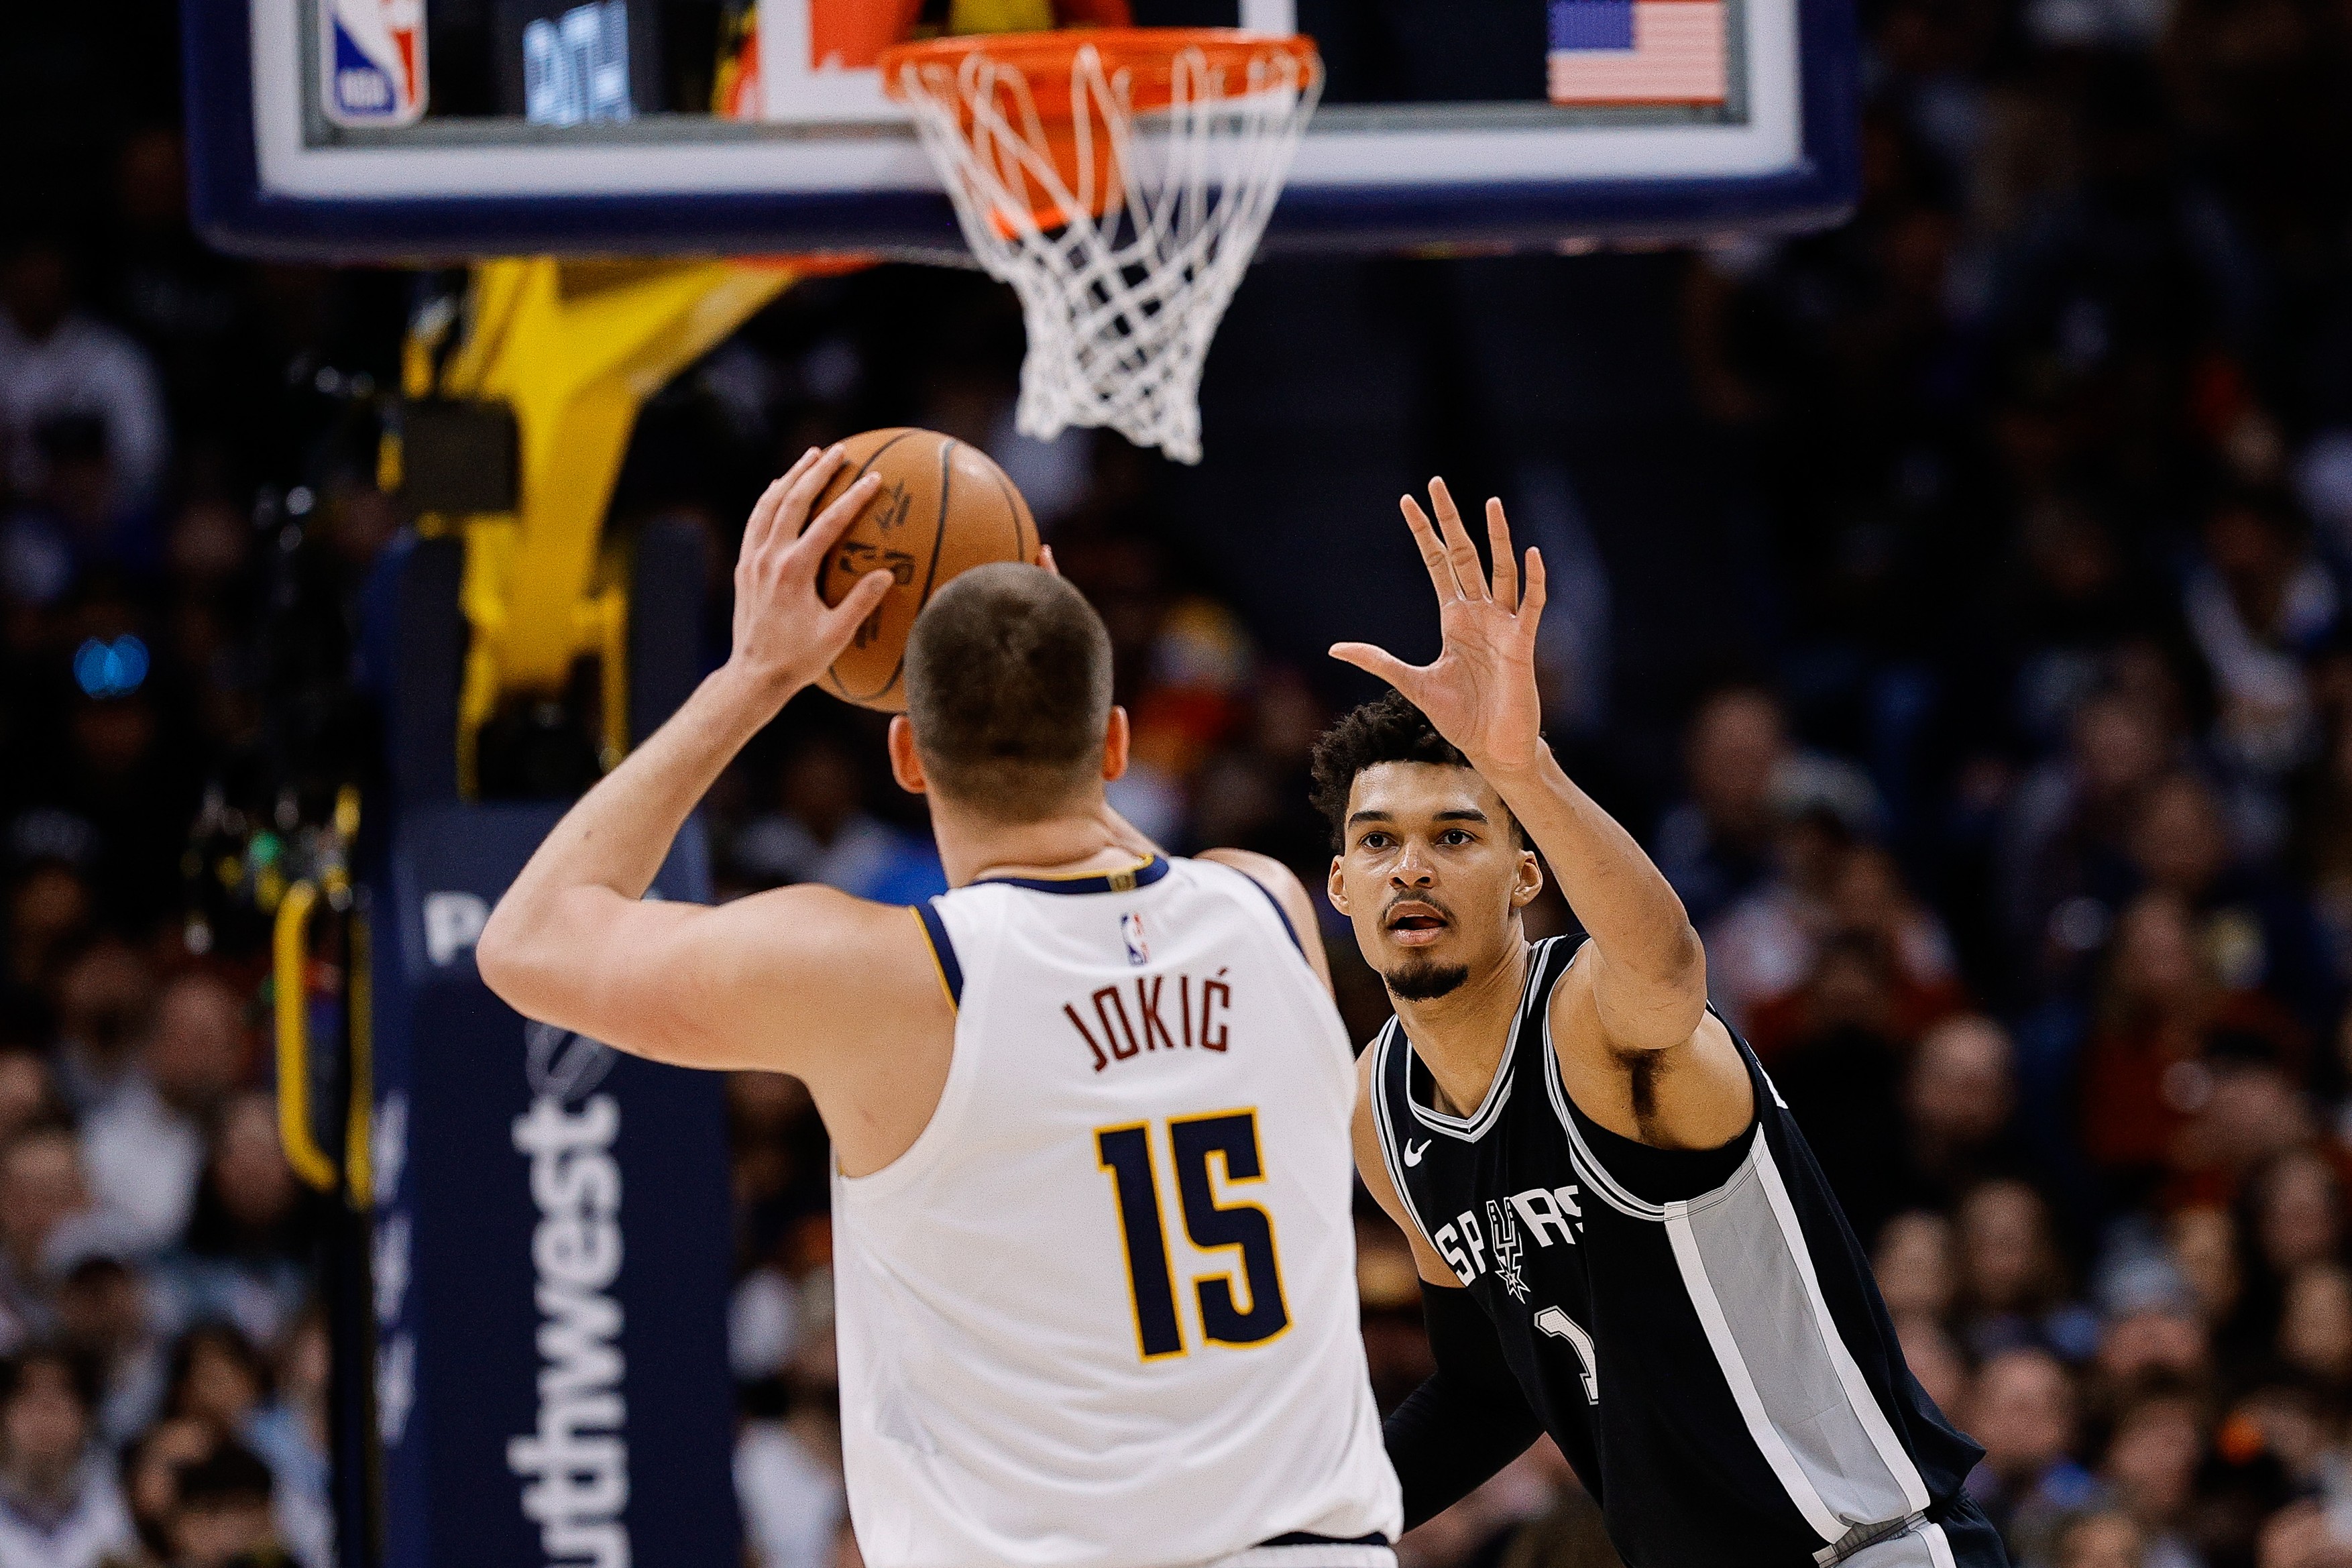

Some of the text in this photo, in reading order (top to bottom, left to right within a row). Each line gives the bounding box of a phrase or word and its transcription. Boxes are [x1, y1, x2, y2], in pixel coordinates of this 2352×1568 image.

[1064, 968, 1232, 1072] JOKIĆ
[1093, 1106, 1294, 1364] 15
[1534, 1305, 1599, 1405] 1
